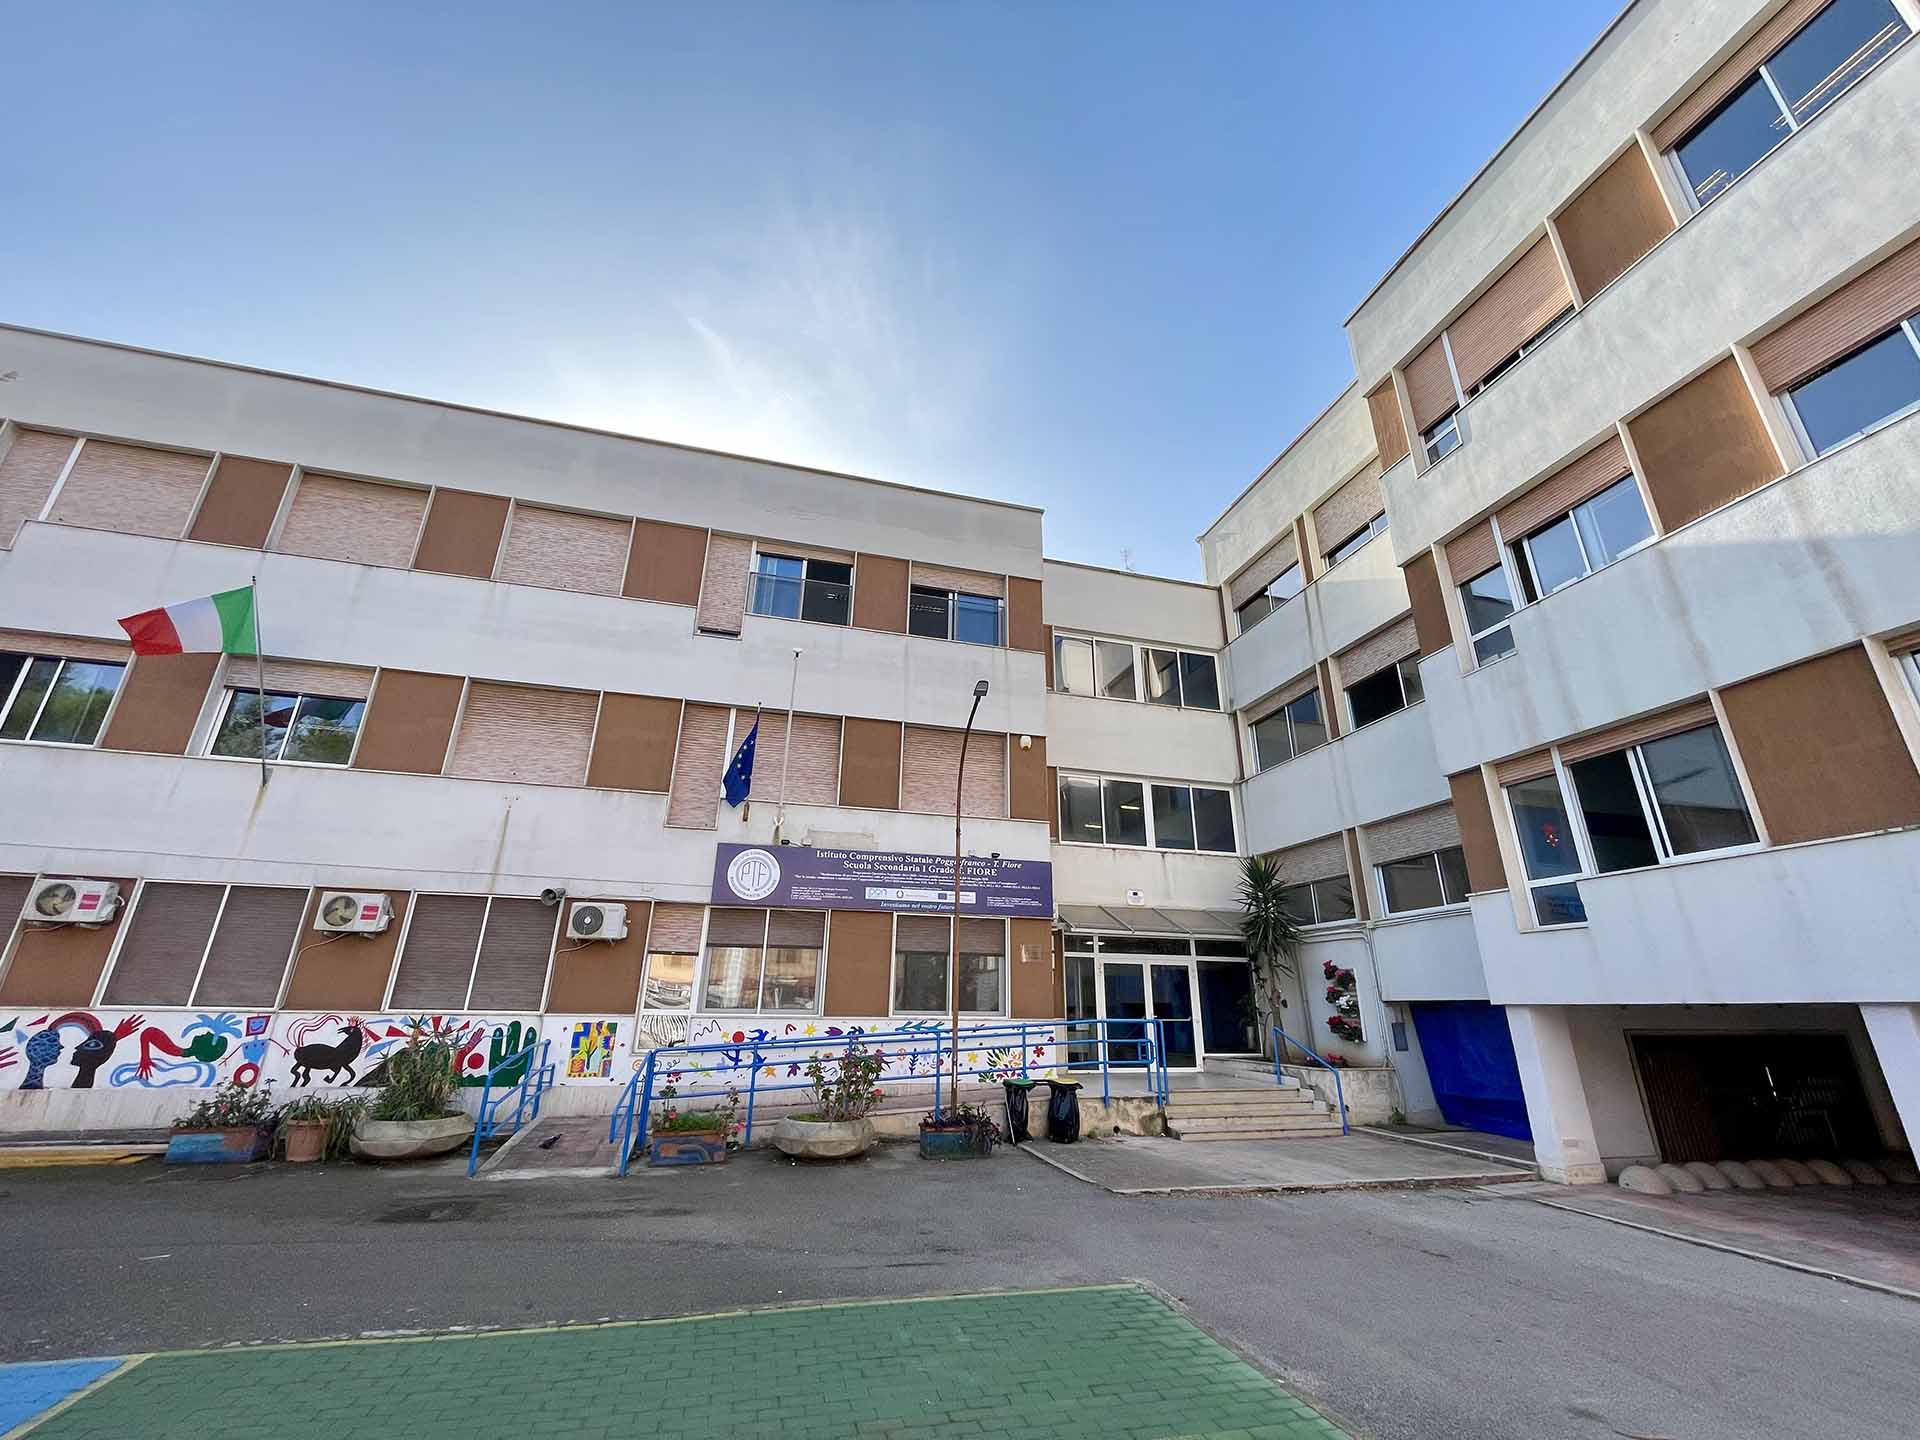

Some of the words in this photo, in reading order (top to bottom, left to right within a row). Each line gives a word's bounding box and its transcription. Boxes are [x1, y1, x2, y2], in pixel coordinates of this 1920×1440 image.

[816, 850, 847, 859] Istituto
[849, 852, 904, 862] Comprensivo
[905, 855, 933, 864] Statale
[935, 856, 986, 867] Poggifranco
[993, 860, 1000, 868] T.
[1002, 860, 1023, 869] Fiore
[843, 860, 872, 869] Scuola
[874, 862, 920, 872] Secondaria
[928, 865, 955, 874] Grado
[967, 867, 998, 876] FIORE
